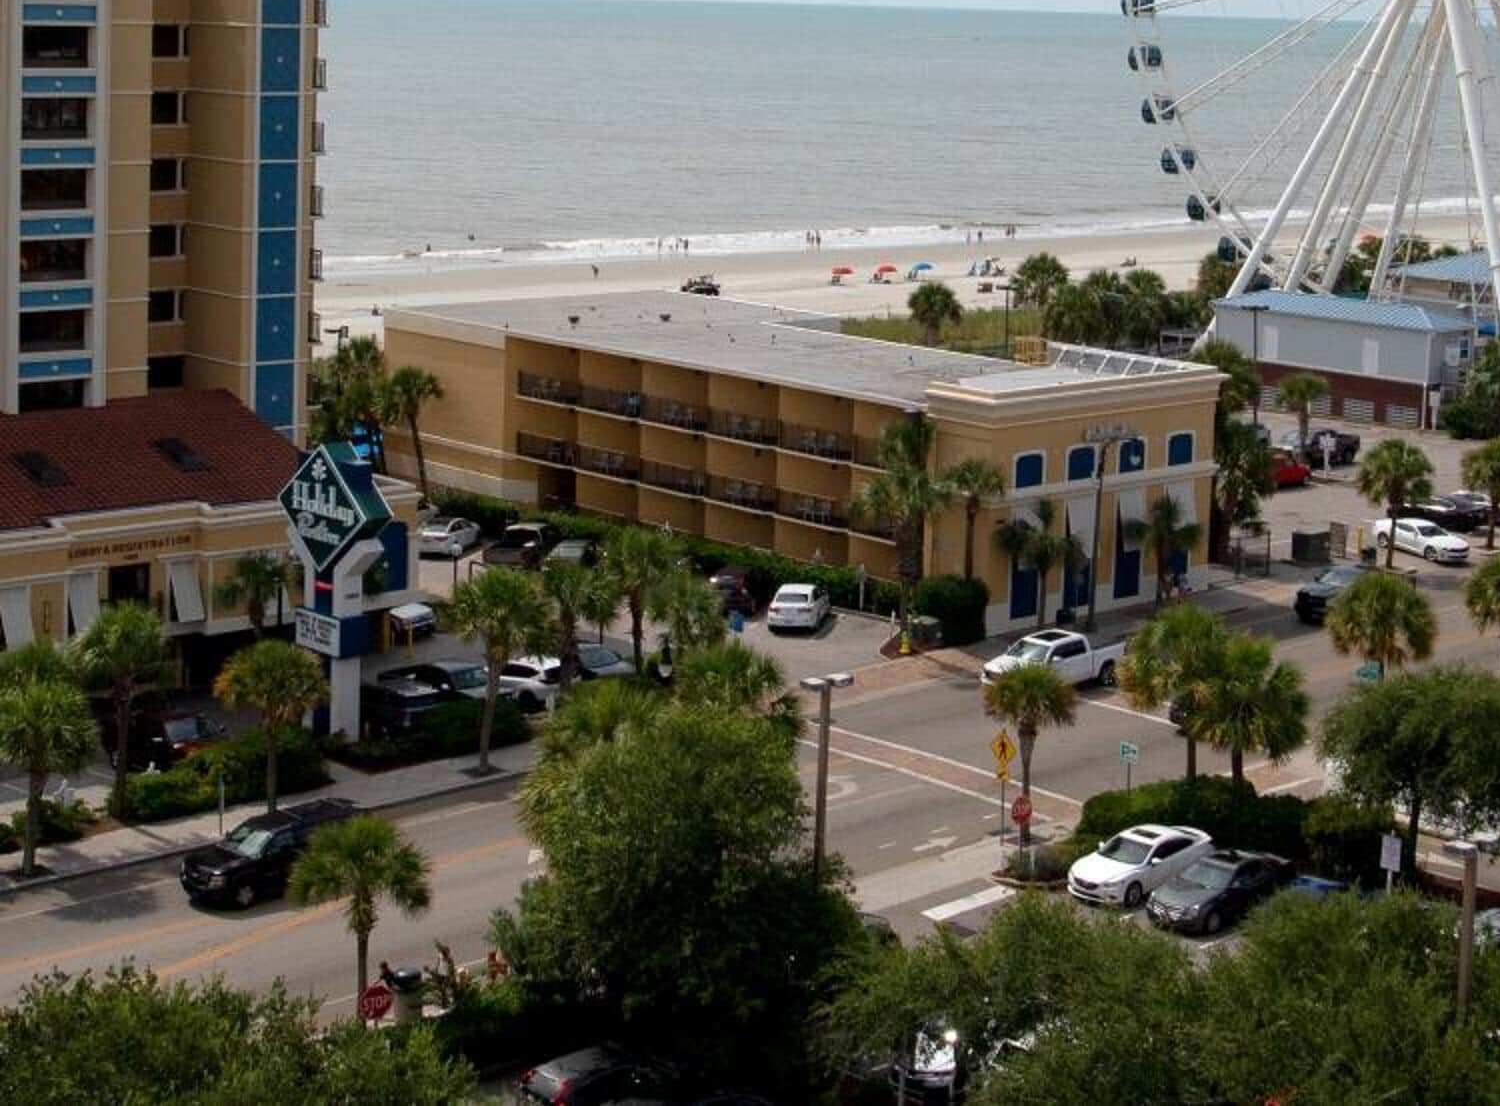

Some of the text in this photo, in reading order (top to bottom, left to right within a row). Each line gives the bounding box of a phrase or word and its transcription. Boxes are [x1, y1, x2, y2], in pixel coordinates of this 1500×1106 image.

[292, 479, 355, 527] Holiday
[111, 534, 191, 553] REGISTRATION
[363, 993, 390, 1011] STOP
